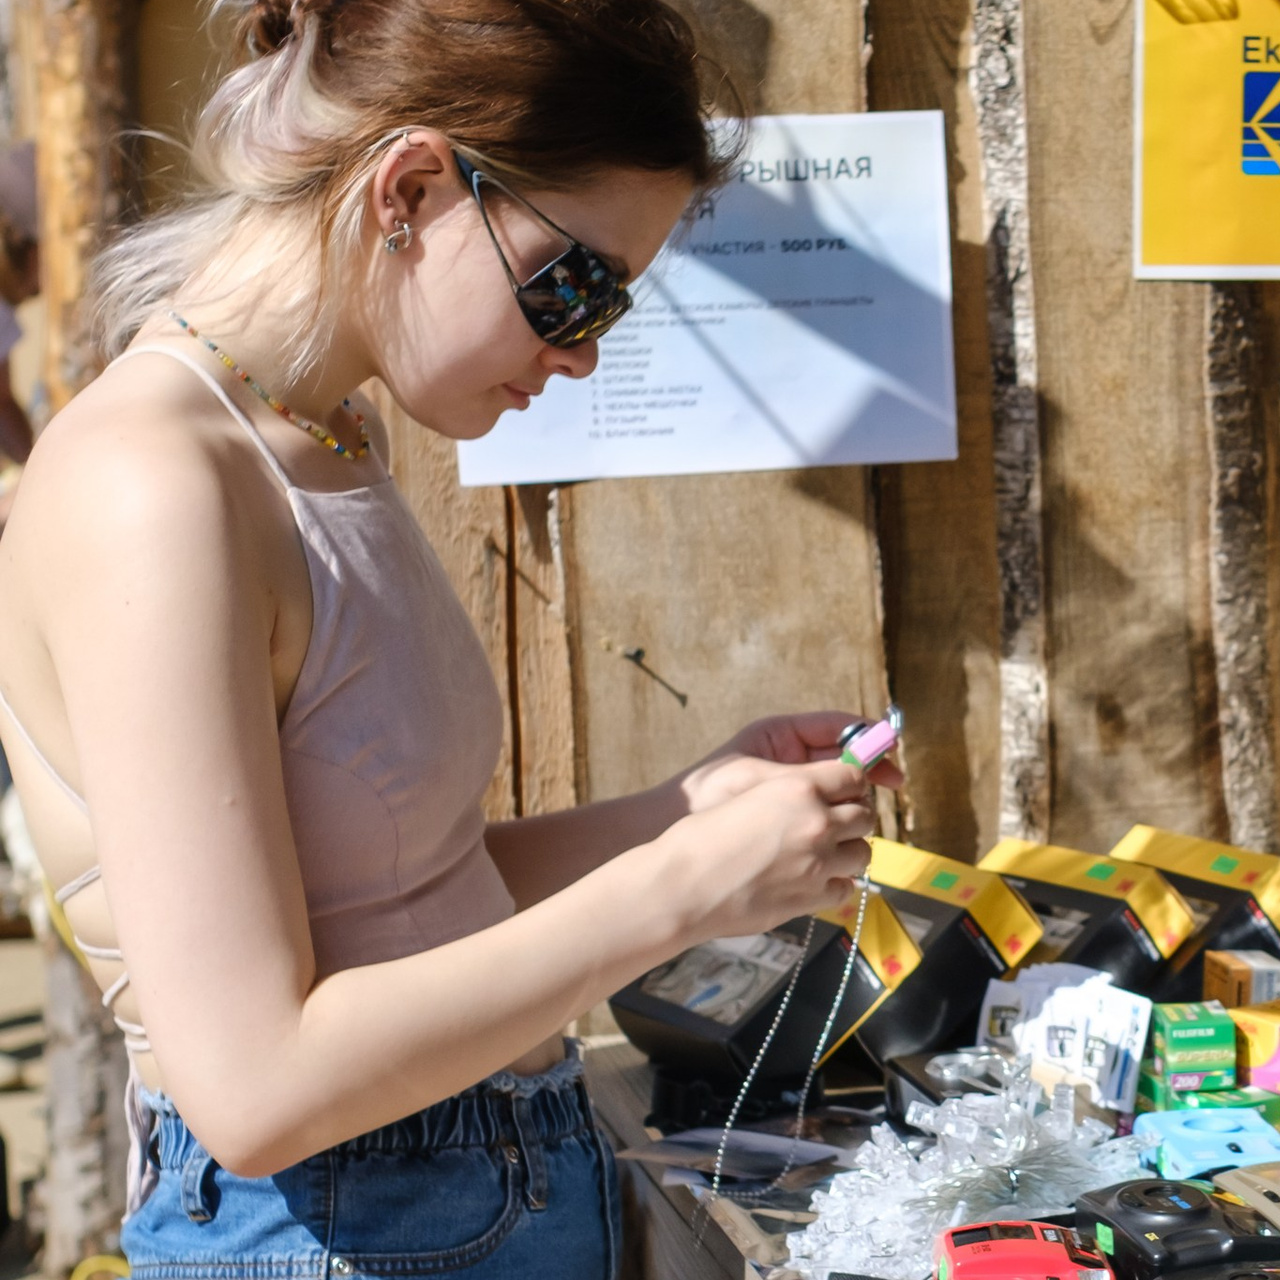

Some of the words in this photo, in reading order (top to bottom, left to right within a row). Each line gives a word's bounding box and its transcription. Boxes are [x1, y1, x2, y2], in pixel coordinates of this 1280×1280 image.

[739, 156, 873, 183] РЫШНАЯ
[690, 239, 766, 256] УЧАСТИЯ
[780, 238, 814, 253] 500
[1172, 1027, 1215, 1038] FUJIFILM
[1174, 1075, 1200, 1088] 200
